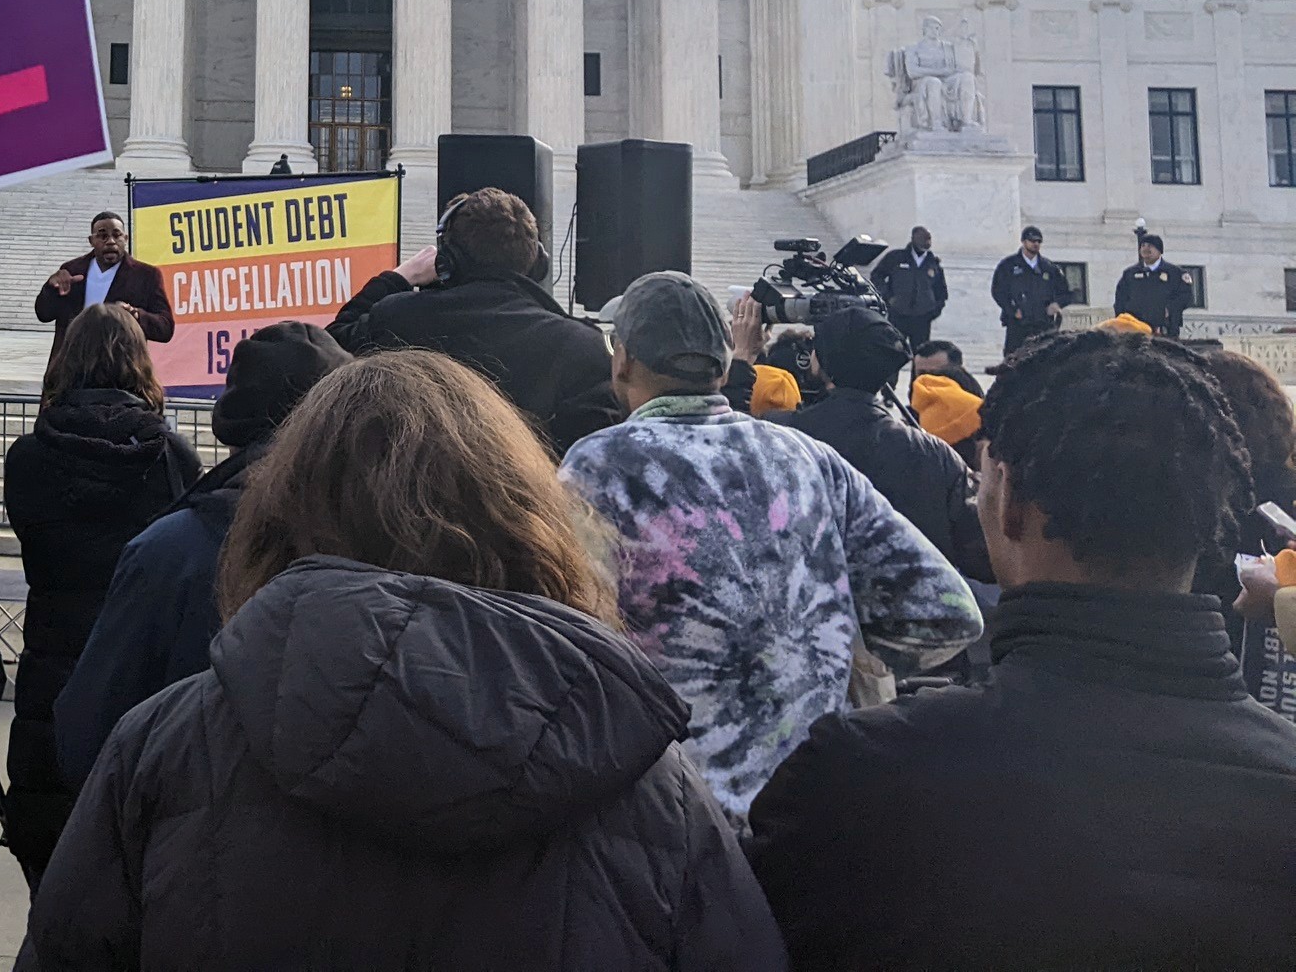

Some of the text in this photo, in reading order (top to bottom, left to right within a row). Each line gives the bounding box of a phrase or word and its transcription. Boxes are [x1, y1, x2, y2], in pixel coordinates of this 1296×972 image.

[169, 192, 349, 255] STUDENT DEBT
[173, 256, 352, 316] CANCELLATION
[207, 330, 231, 375] IS
